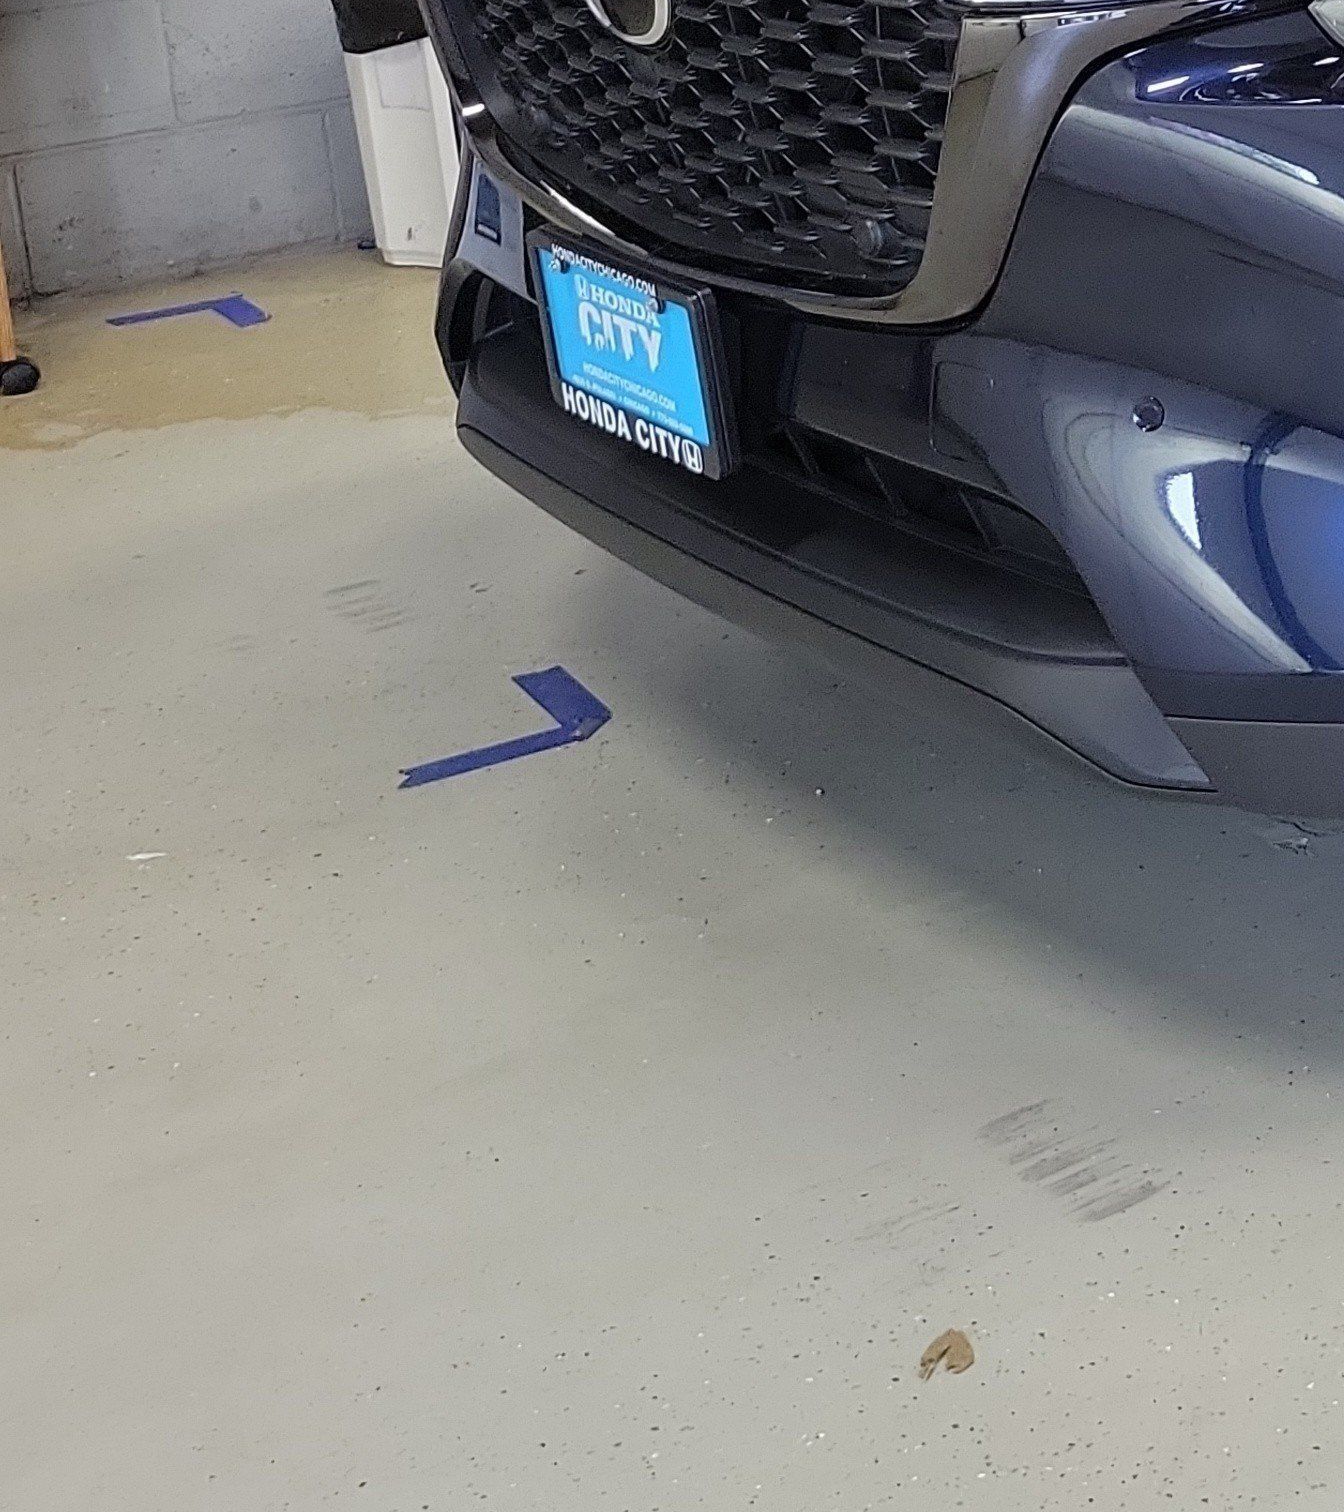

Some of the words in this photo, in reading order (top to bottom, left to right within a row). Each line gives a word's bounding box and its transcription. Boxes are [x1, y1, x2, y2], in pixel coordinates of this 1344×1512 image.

[579, 301, 662, 372] CITY
[561, 381, 632, 442] HONDA
[635, 418, 681, 464] CITY
